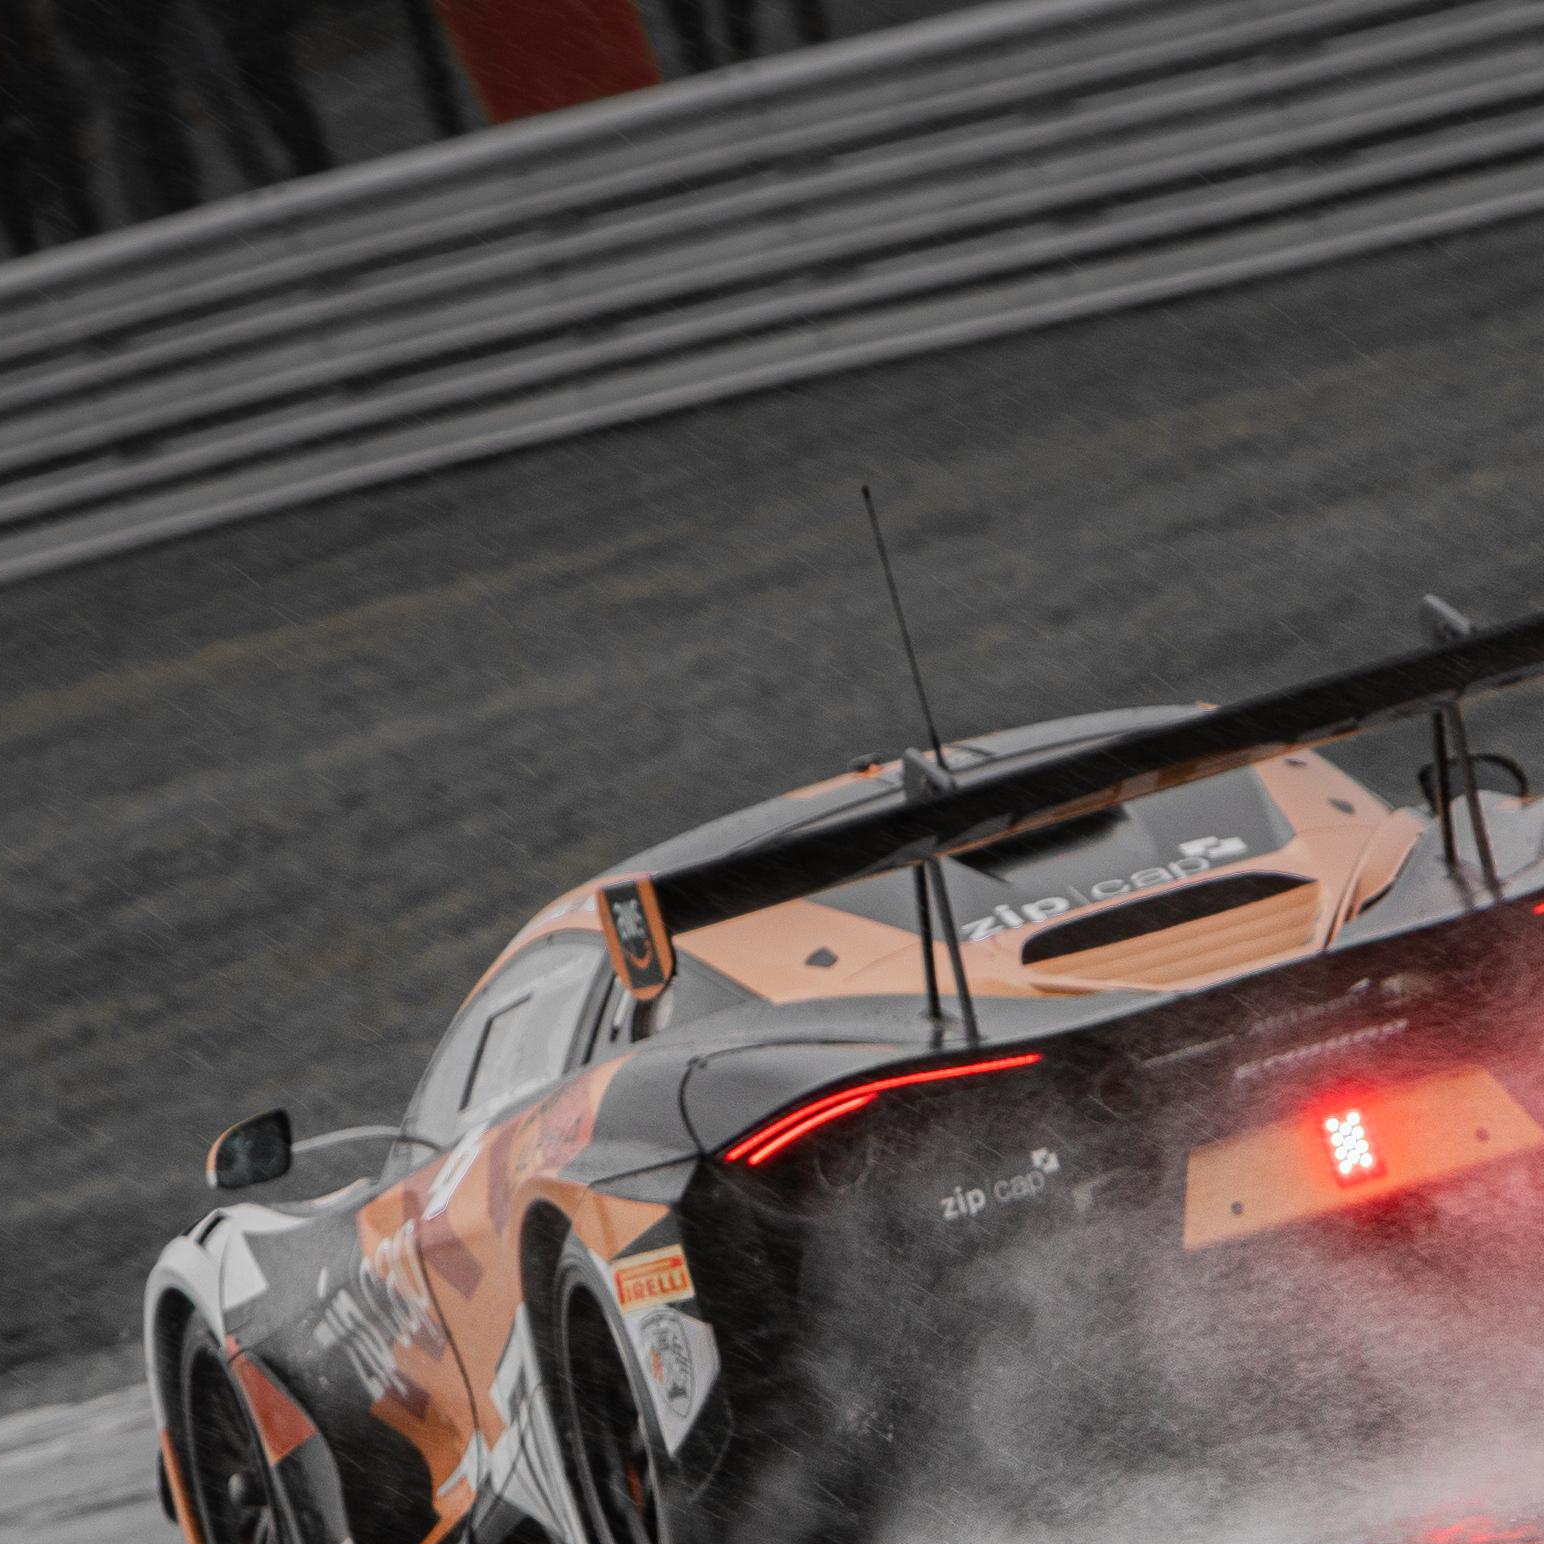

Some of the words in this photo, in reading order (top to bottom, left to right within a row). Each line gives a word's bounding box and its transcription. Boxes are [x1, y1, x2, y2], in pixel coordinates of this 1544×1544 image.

[960, 896, 1071, 943] zip
[1090, 855, 1211, 901] cap
[939, 1185, 987, 1222] zip
[993, 1170, 1046, 1202] cap
